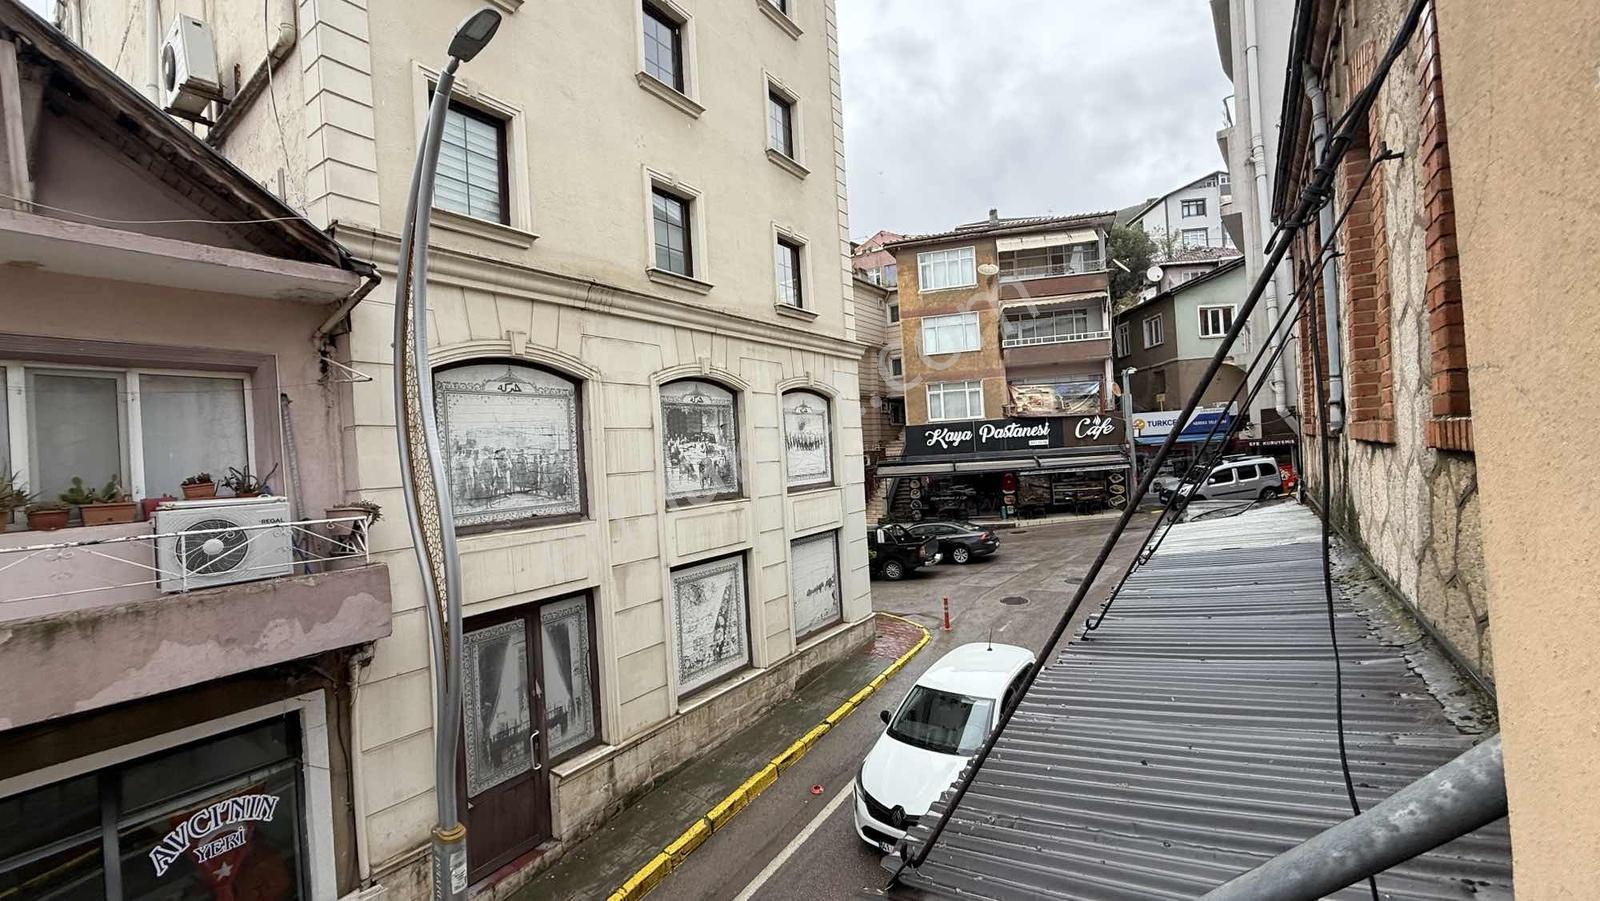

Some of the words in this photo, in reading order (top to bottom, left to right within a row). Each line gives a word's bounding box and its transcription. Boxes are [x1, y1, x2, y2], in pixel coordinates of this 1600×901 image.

[925, 428, 973, 449] Kaya
[979, 421, 1050, 443] Pastanesi
[1074, 417, 1116, 440] Cafe
[261, 517, 285, 525] REGAL
[148, 794, 280, 877] AVCI'NIN
[193, 825, 246, 863] YERİ
